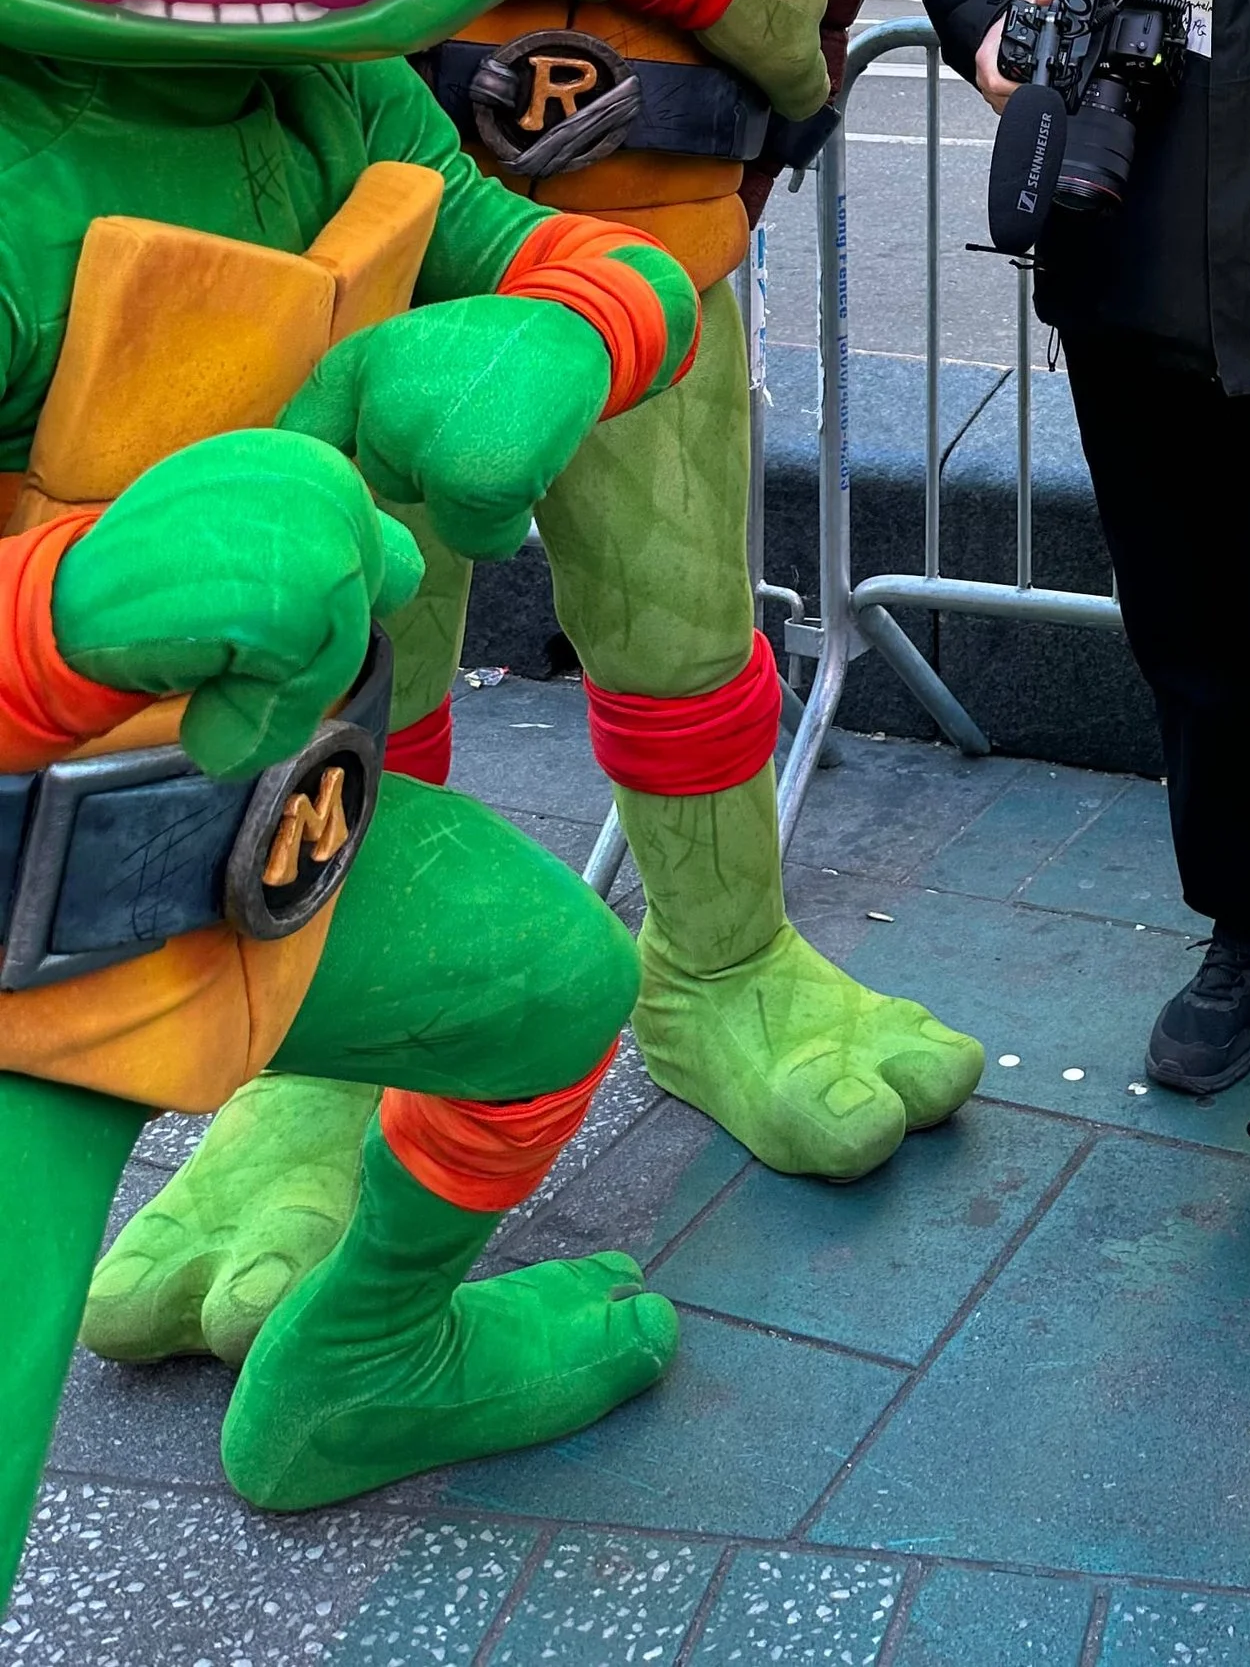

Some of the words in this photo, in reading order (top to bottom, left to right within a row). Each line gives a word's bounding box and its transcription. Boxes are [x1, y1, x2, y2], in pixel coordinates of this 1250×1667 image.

[519, 55, 597, 131] R
[1027, 112, 1052, 188] SENNHEISER
[835, 195, 847, 248] Long
[262, 766, 349, 886] M
